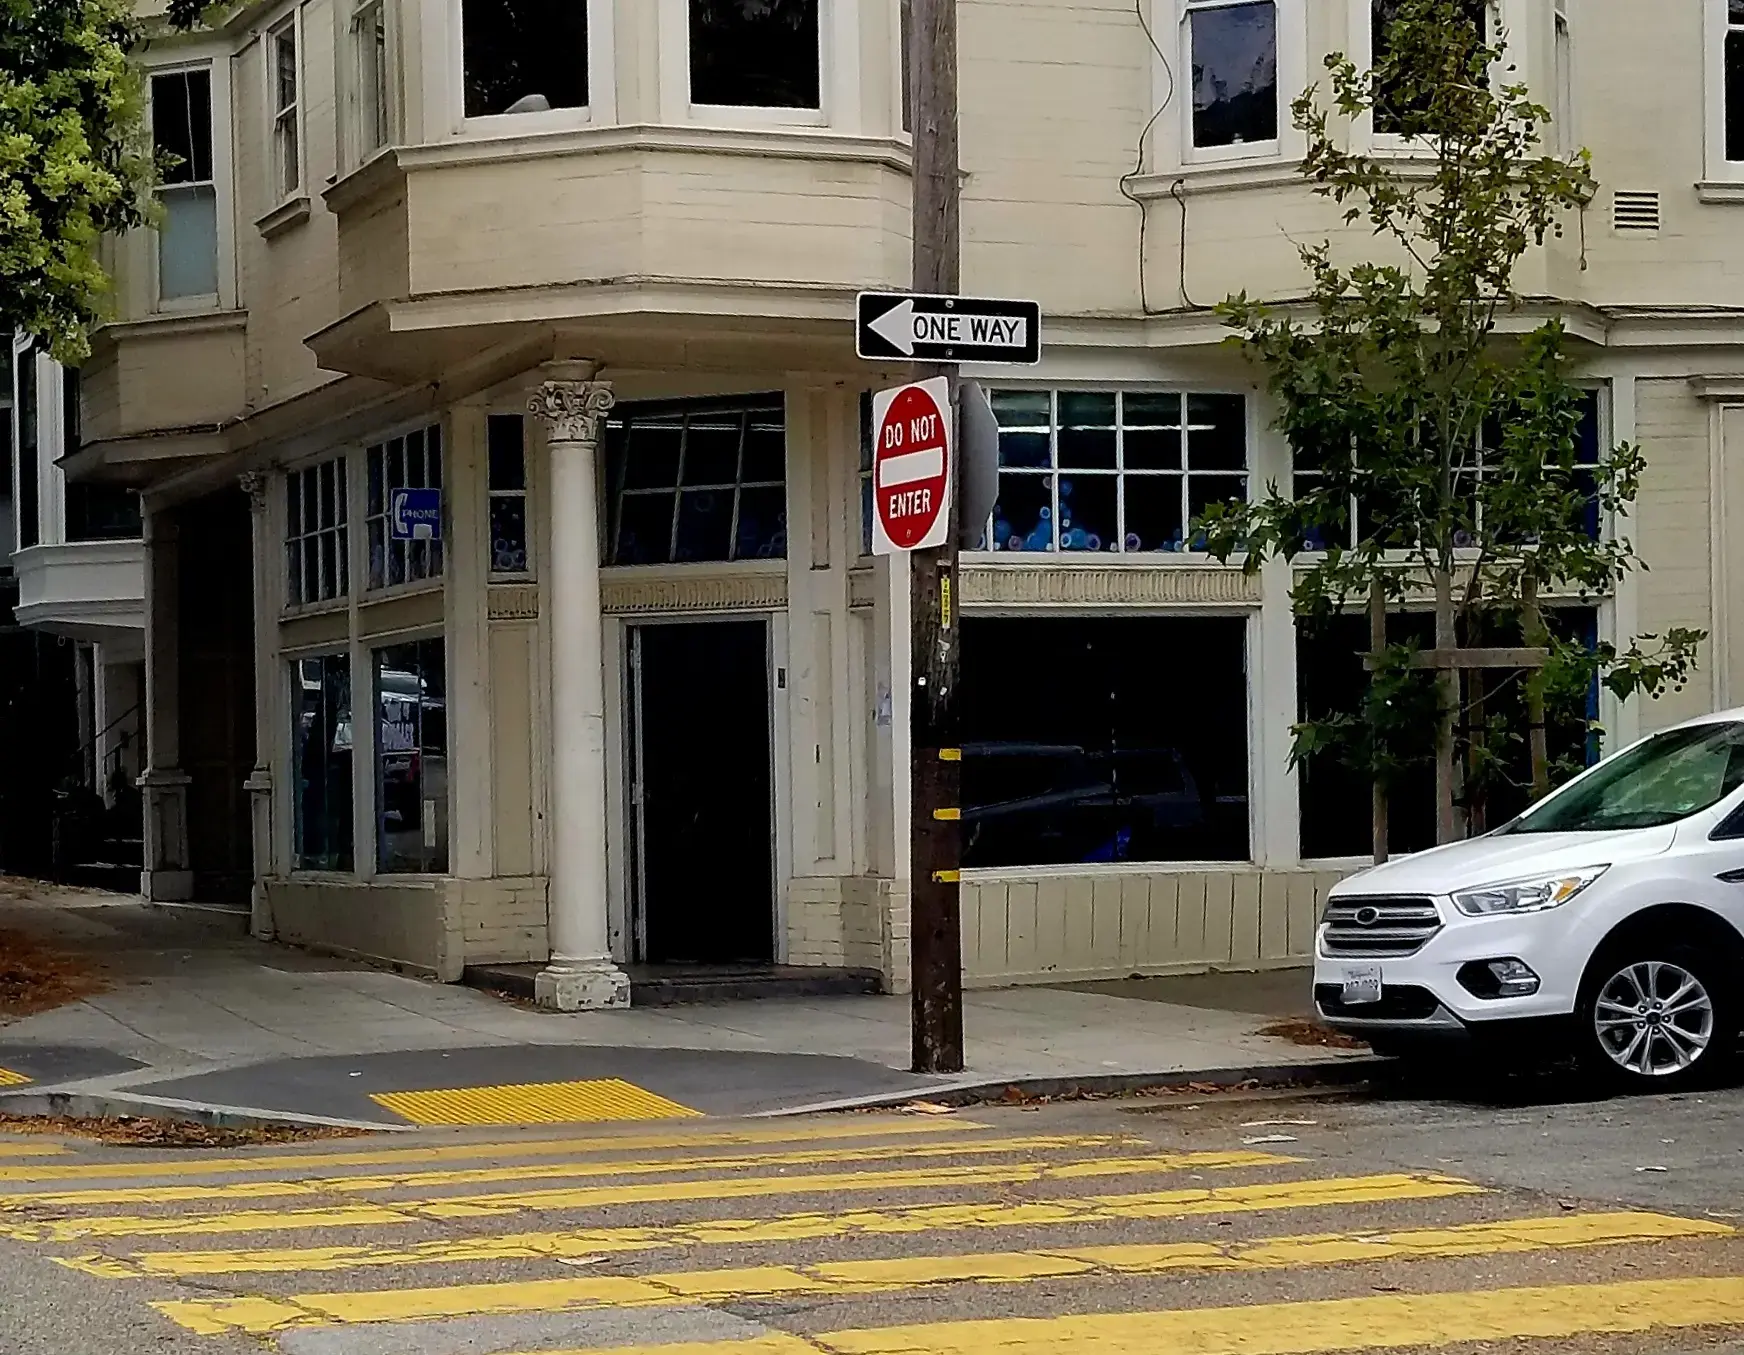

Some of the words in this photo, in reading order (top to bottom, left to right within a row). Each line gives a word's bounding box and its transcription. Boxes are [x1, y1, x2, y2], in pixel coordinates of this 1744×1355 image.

[913, 316, 961, 342] ONE
[970, 318, 1020, 344] WAY
[885, 422, 903, 449] DO
[910, 414, 937, 443] NOT
[402, 509, 439, 519] PHONE
[889, 488, 931, 519] ENTER
